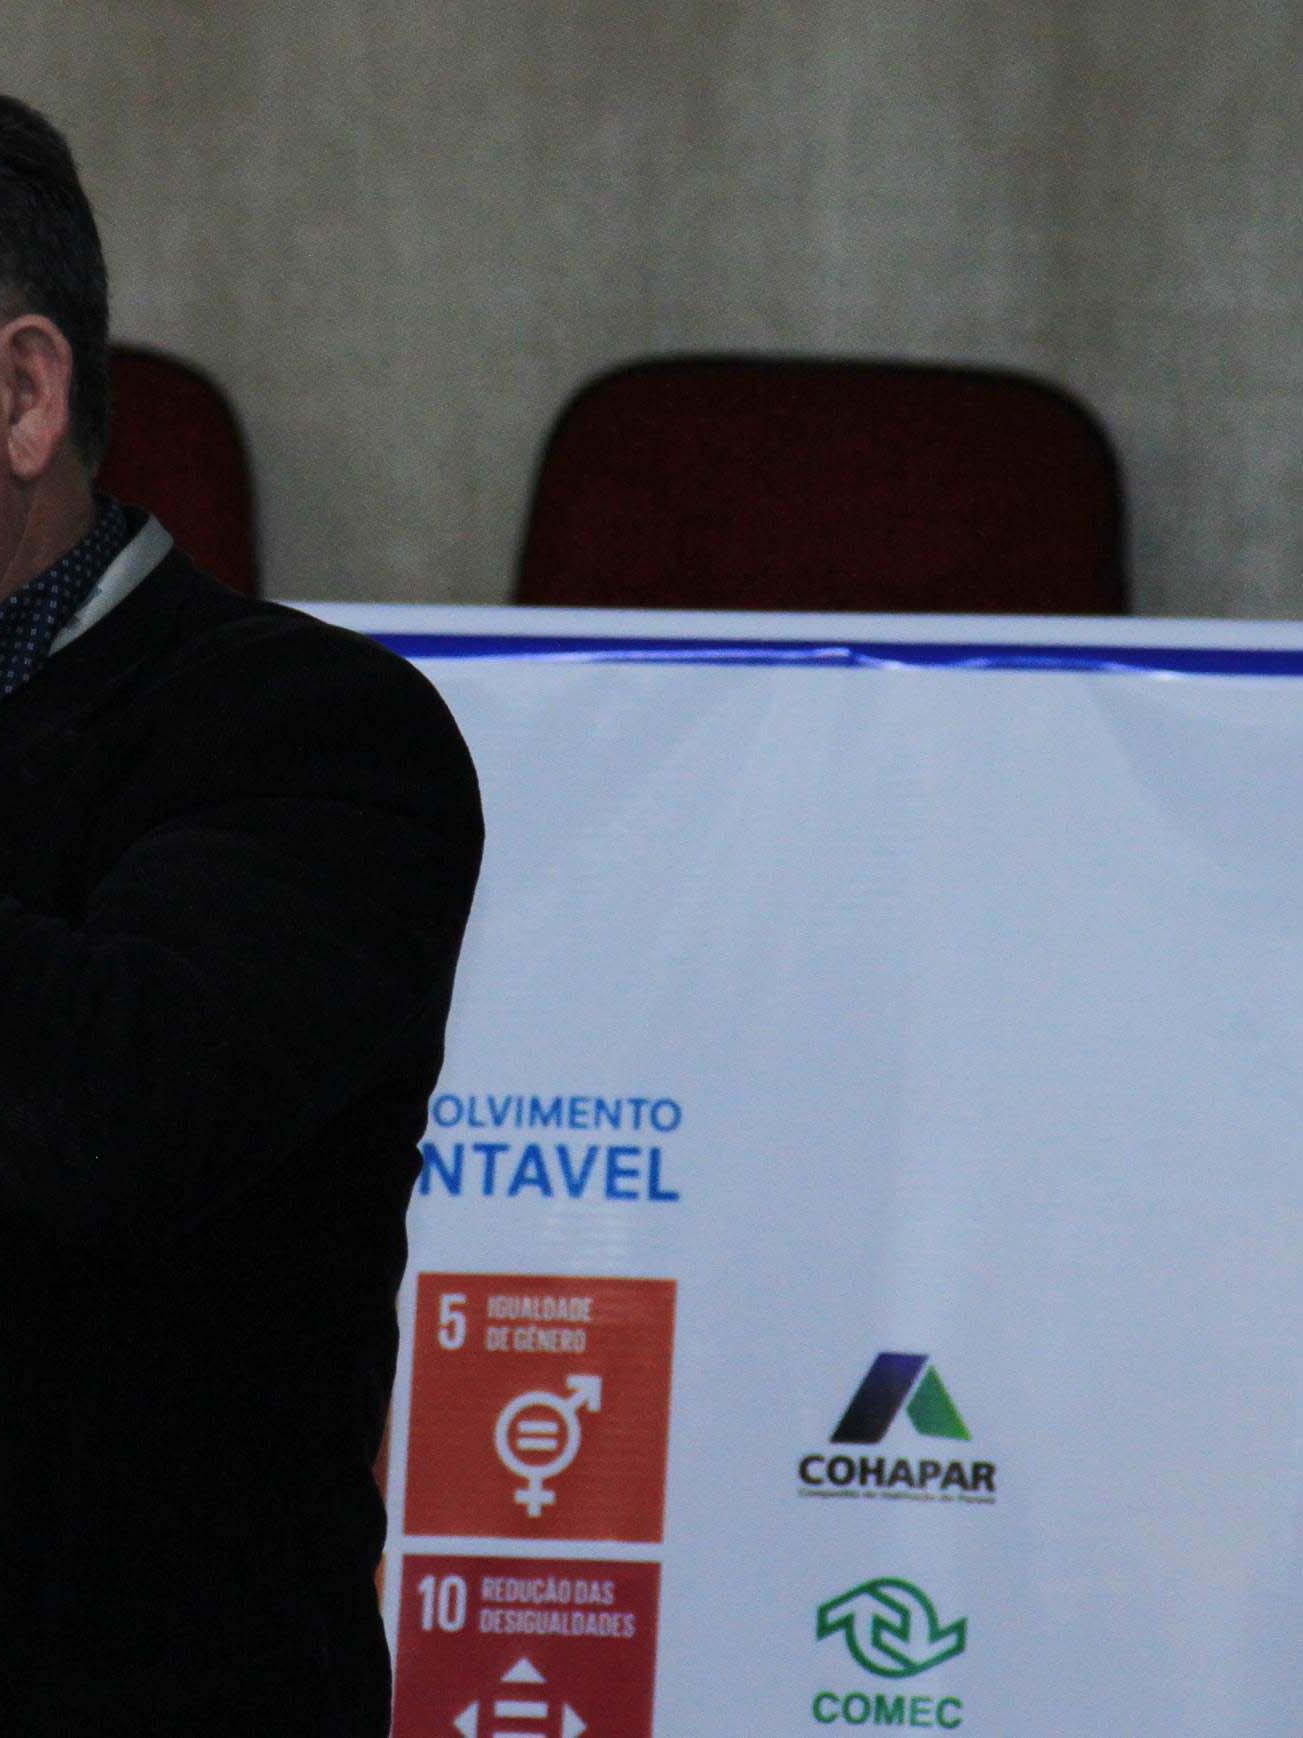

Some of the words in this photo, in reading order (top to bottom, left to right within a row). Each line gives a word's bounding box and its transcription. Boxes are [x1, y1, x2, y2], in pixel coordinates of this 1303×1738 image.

[438, 1293, 466, 1350] 5
[487, 1296, 592, 1322] IGUALDADE
[486, 1327, 509, 1351] DE
[798, 1454, 995, 1492] COHAPAR
[418, 1575, 467, 1632] 10
[575, 1580, 615, 1604] DAS
[480, 1609, 636, 1638] DESIGUALDADES
[812, 1691, 963, 1728] COMEC
